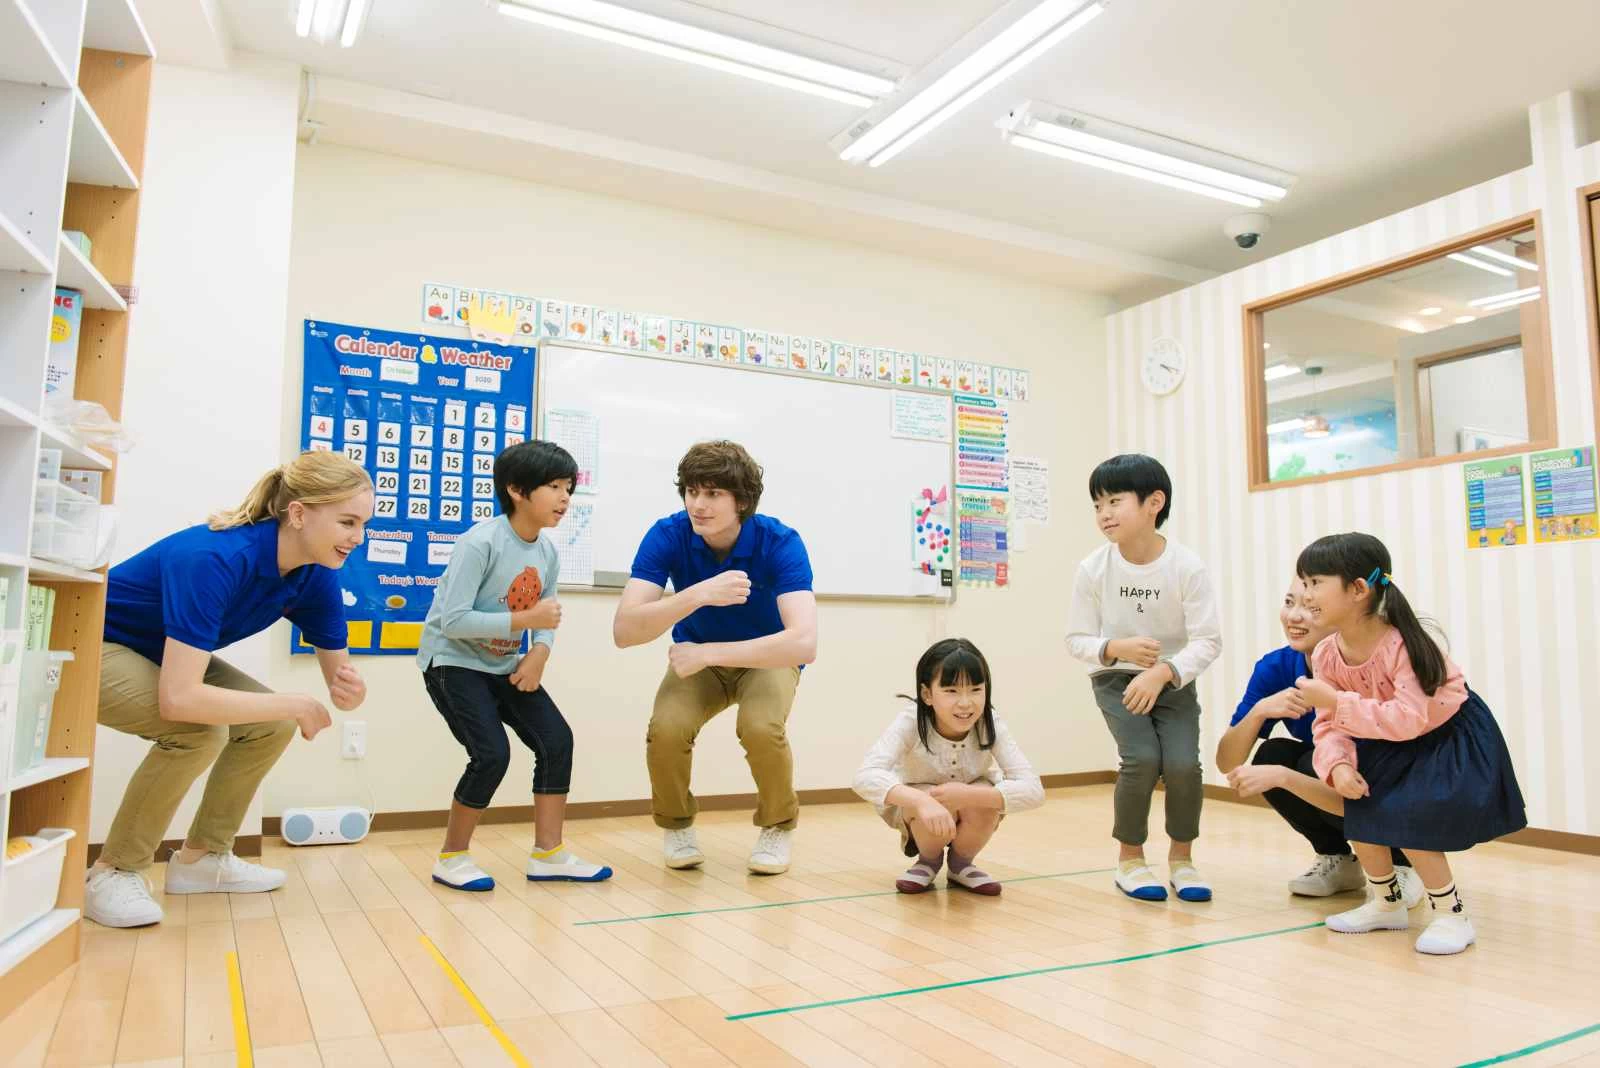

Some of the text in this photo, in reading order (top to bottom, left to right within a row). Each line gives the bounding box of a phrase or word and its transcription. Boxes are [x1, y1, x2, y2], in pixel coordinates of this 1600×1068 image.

[430, 287, 449, 300] Aa
[514, 299, 532, 312] Dd
[546, 302, 561, 314] Ee
[335, 335, 512, 371] Calendar & Weather
[340, 365, 372, 378] Month
[437, 376, 459, 387] Year
[453, 410, 519, 426] 1 2 3
[318, 421, 327, 433] 4
[352, 425, 359, 436] 5
[385, 427, 393, 439] 6
[418, 430, 426, 441] 7
[450, 433, 457, 444] 8
[481, 436, 489, 447] 9
[347, 448, 490, 471] 12 13 14 15 16
[379, 476, 491, 494] 20 21 22 23
[377, 501, 491, 518] 27 28 29 30
[367, 529, 413, 542] Yesterday
[378, 575, 440, 588] Today's Weat
[1120, 586, 1160, 600] HAPPY
[1136, 603, 1144, 614] &
